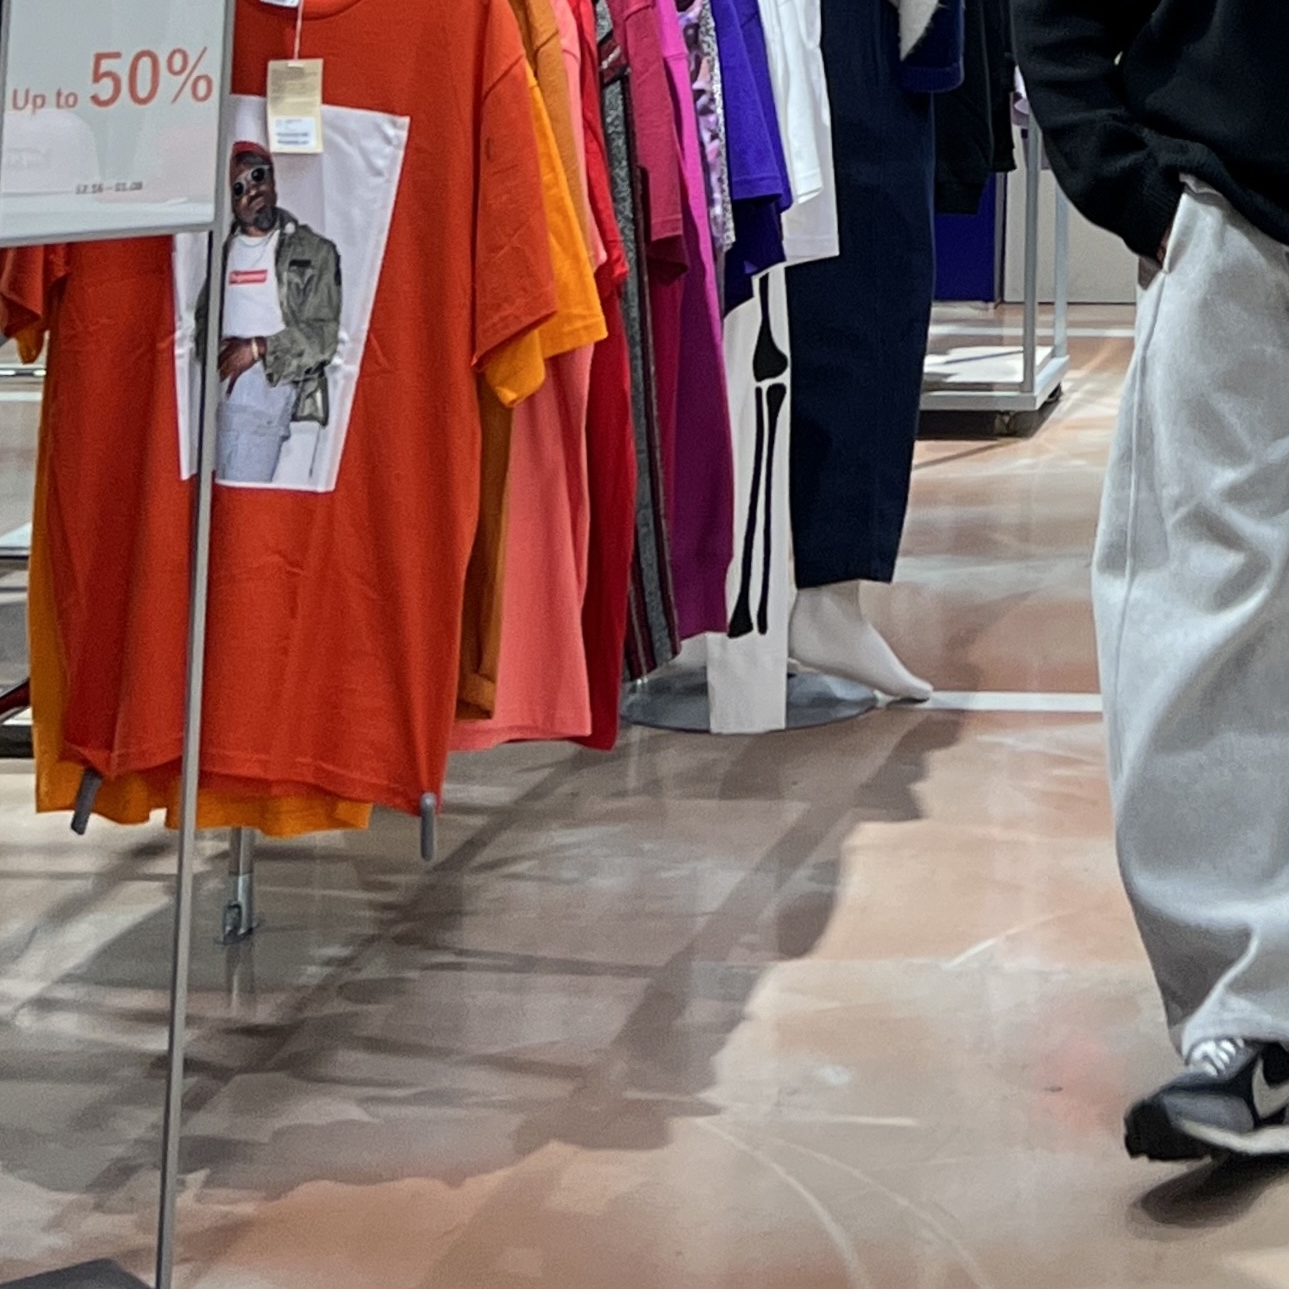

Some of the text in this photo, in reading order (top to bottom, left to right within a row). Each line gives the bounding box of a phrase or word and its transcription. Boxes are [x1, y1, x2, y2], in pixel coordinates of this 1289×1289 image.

[12, 47, 214, 114] Up to 50%
